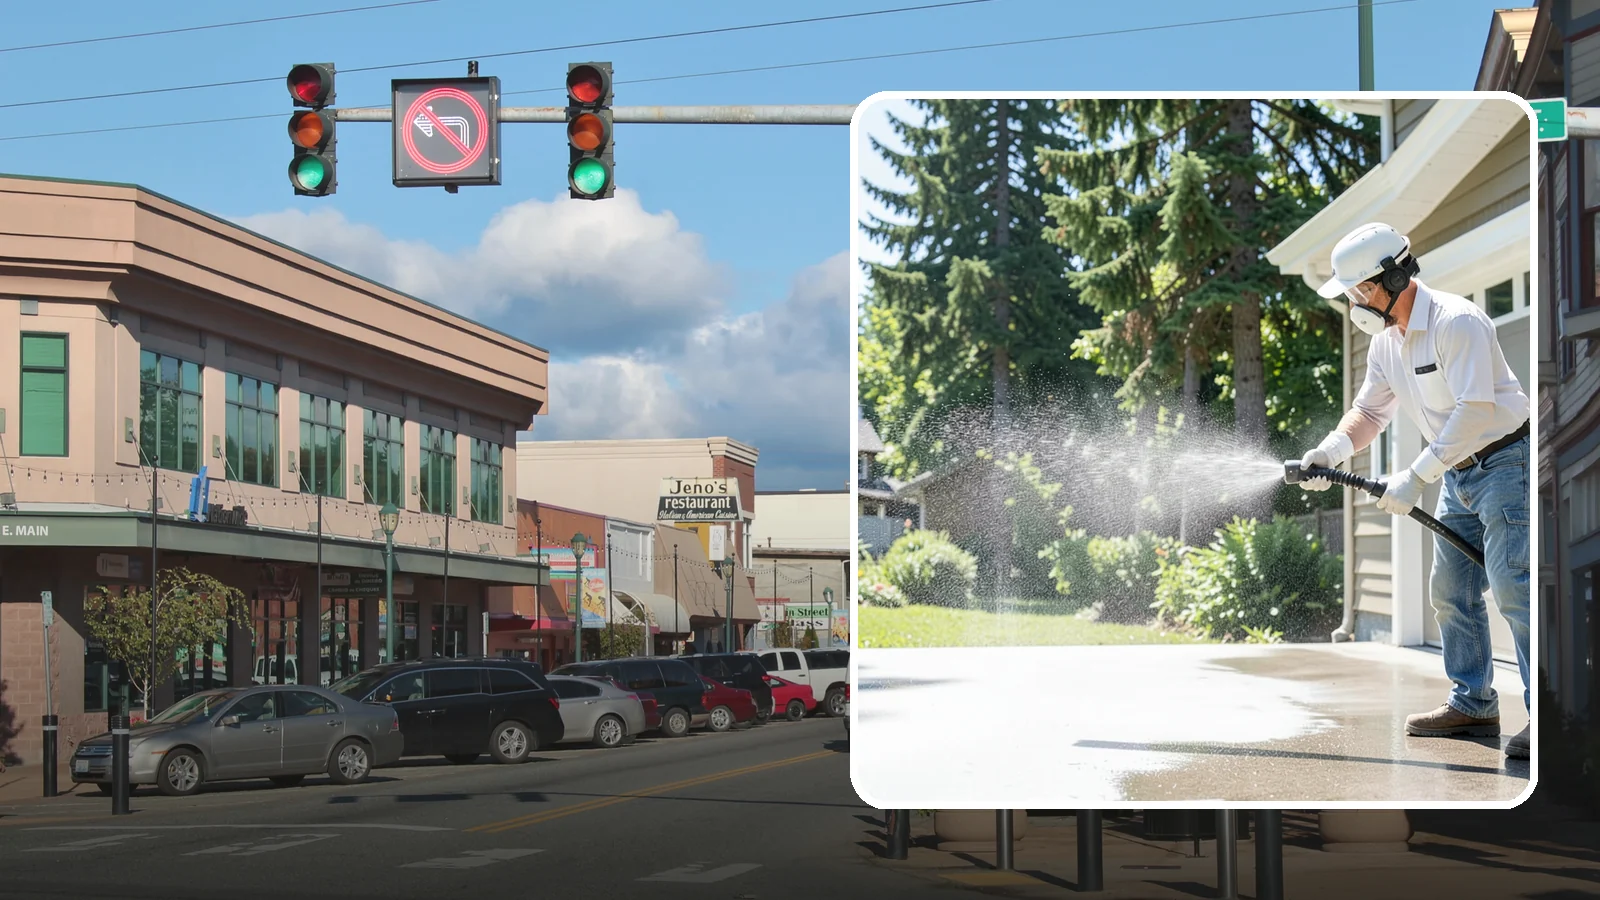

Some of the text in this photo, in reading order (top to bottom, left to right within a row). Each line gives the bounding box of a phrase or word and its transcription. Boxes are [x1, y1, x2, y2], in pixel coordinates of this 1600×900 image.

[670, 480, 728, 494] Jeno's
[665, 497, 731, 508] restaurant
[686, 510, 714, 520] American
[715, 510, 738, 519] Cuisine
[2, 525, 48, 536] E. MAIN
[797, 608, 828, 617] Street
